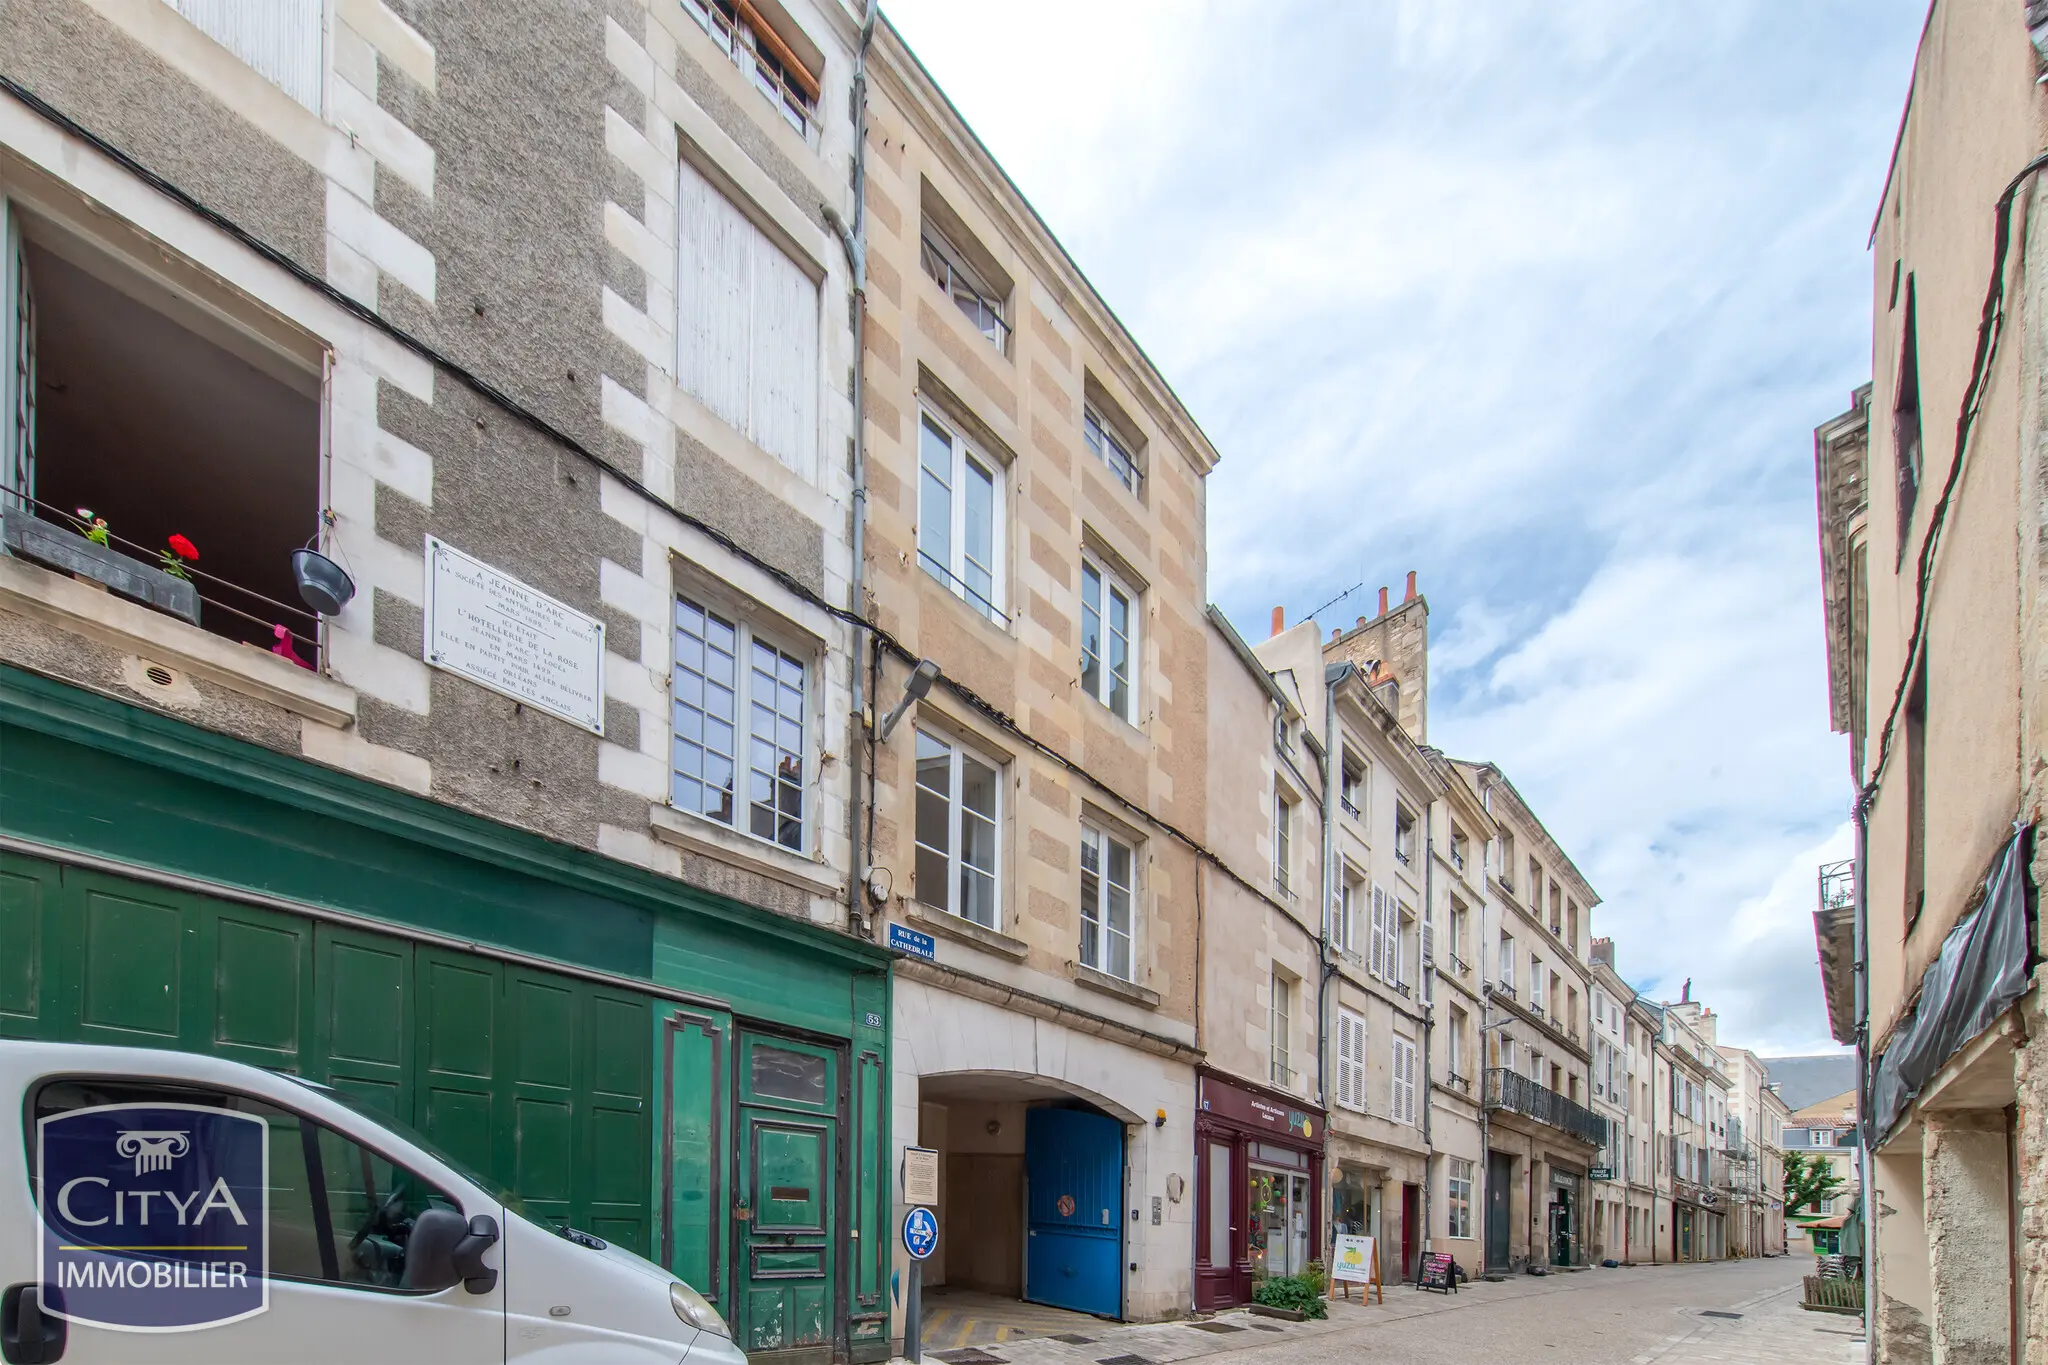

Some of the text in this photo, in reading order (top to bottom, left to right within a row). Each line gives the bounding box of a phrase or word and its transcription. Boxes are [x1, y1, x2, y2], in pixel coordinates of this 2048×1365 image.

[440, 564, 450, 574] LA
[488, 587, 502, 598] DES
[505, 595, 550, 623] ANTIQUAIRES
[553, 619, 562, 628] DE
[565, 625, 592, 643] L'OUEST
[488, 577, 529, 603] JEANNE
[536, 600, 564, 621] D'ARC
[497, 601, 520, 617] MARS
[502, 619, 511, 628] ICI
[470, 624, 501, 643] JEANNE
[507, 641, 529, 656] D'ARC
[528, 640, 538, 651] DE
[543, 647, 552, 658] LA
[440, 630, 459, 643] ELLE
[464, 641, 475, 651] EN
[480, 648, 505, 664] PARTIT
[511, 661, 529, 675] POUR
[534, 672, 556, 686] ALLER
[489, 642, 500, 652] EN
[506, 650, 528, 665] MARS
[502, 677, 516, 688] PAR
[521, 685, 535, 696] LES
[898, 930, 928, 945] RUE de la
[891, 939, 933, 958] CATHEDRALE
